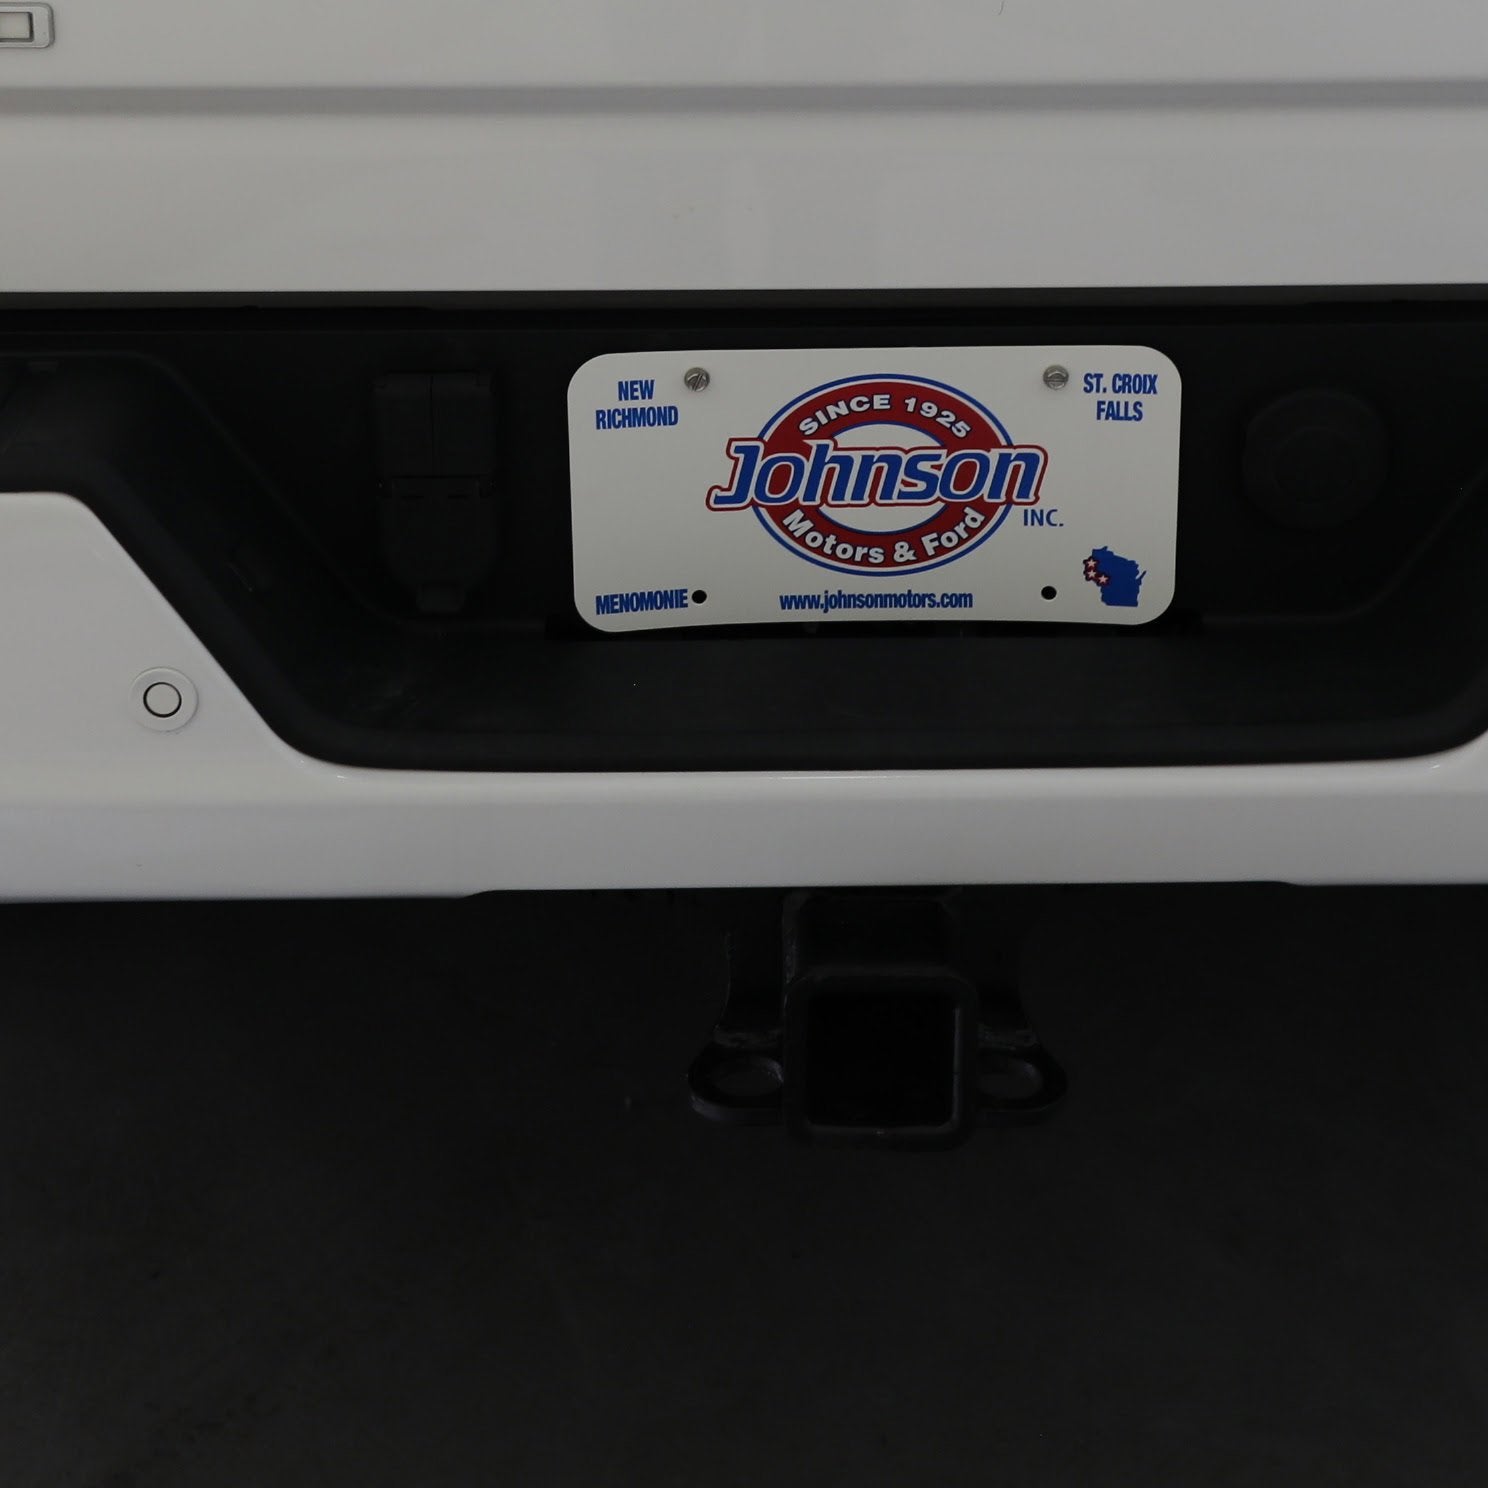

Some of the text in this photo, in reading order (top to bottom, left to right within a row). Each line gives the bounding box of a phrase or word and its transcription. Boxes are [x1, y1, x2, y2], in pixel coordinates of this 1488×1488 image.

[617, 379, 656, 401] NEW
[1083, 372, 1159, 395] ST. CROIX
[595, 405, 679, 430] RICHMOND
[798, 393, 972, 440] SINCE 1925
[1096, 399, 1144, 422] FALLS
[710, 440, 1044, 509] Johnson
[1023, 508, 1064, 527] INC.
[781, 507, 986, 565] Motors & Ford
[595, 589, 689, 615] MENOMONIE
[779, 590, 974, 613] www.johnsonmotors.com
